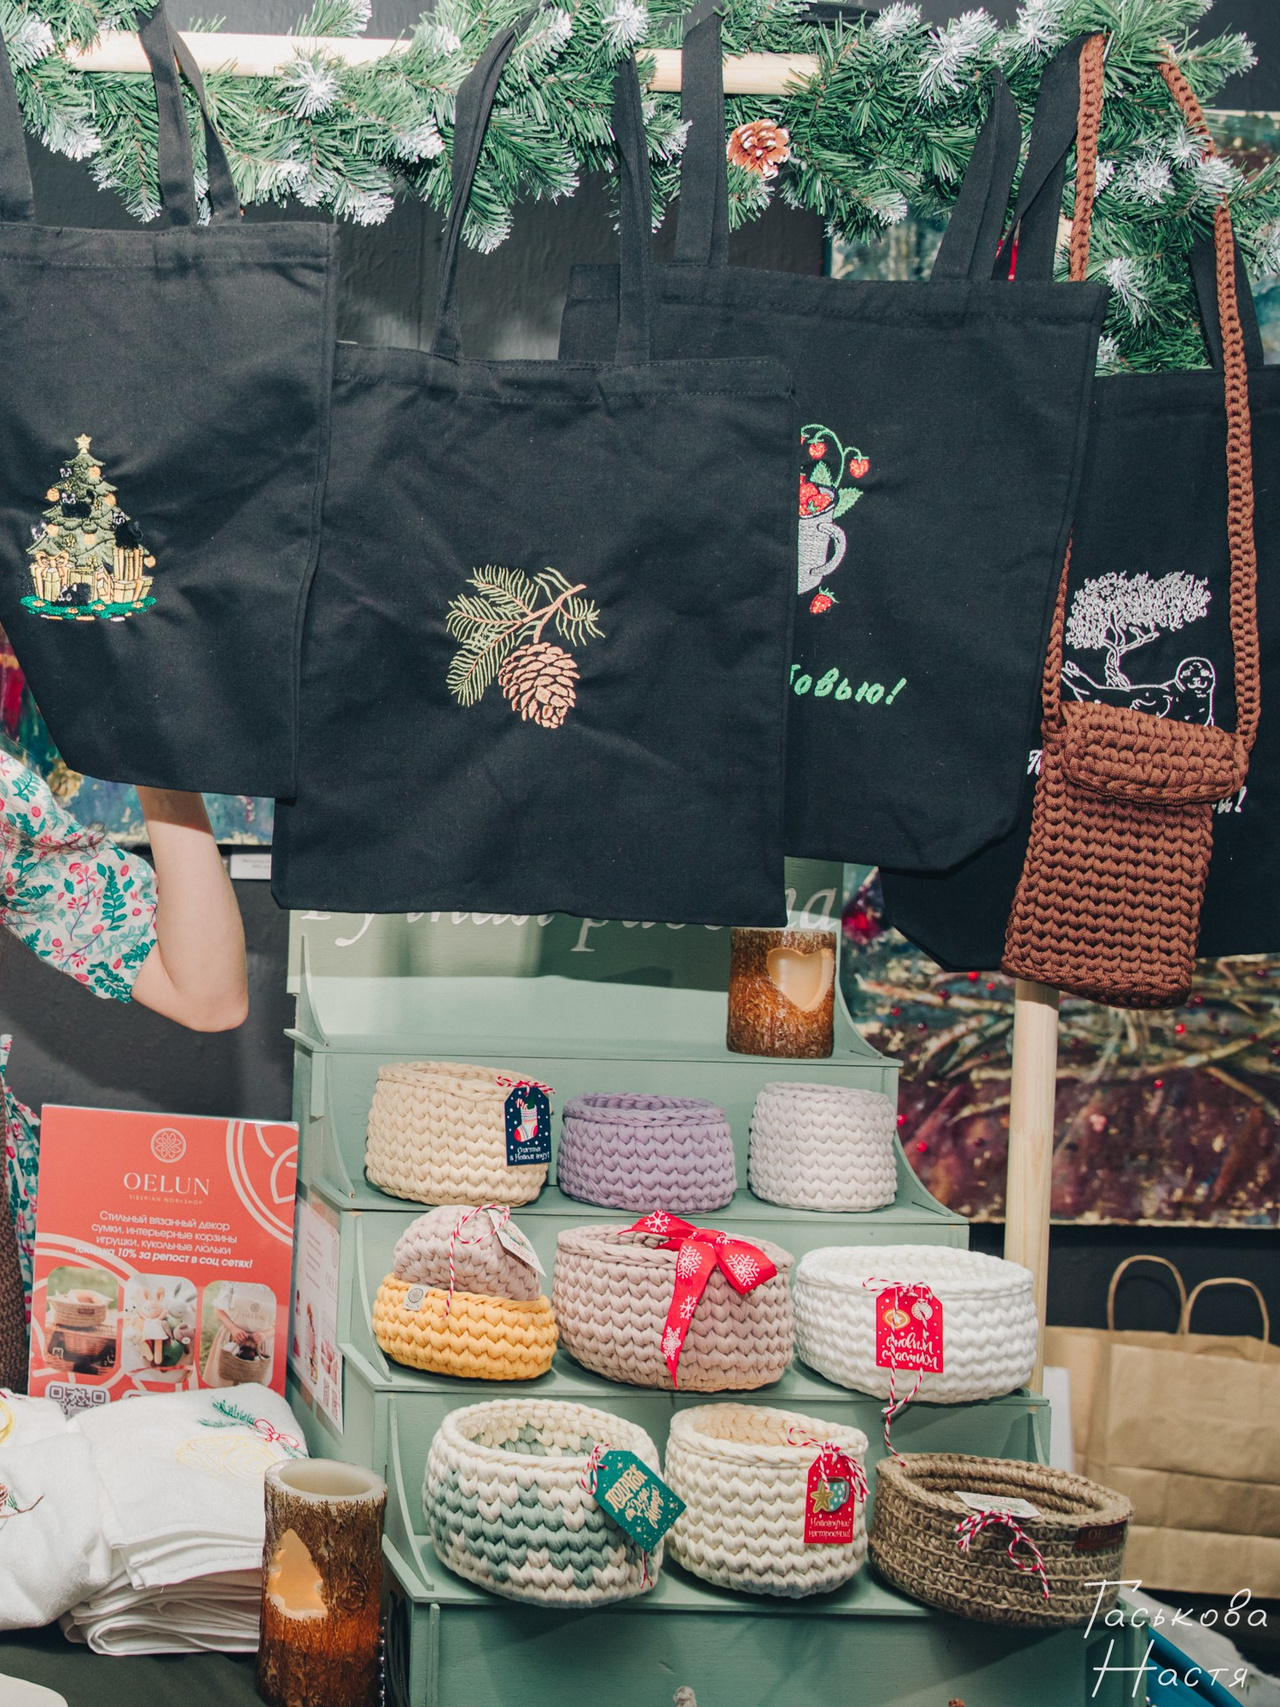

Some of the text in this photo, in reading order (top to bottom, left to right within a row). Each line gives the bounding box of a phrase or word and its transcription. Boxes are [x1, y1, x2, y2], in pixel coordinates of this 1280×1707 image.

[123, 1172, 210, 1196] OELUN
[129, 1194, 203, 1205] SIBERIAN WORKSHOP
[99, 1211, 231, 1232] Стильный вязанный декор
[126, 1227, 193, 1239] интерьерные
[194, 1233, 238, 1244] корзины
[141, 1239, 193, 1252] кукольные
[194, 1245, 232, 1255] люльки
[118, 1247, 137, 1258] 10%
[138, 1250, 151, 1260] за
[151, 1251, 190, 1264] репост
[190, 1256, 198, 1264] в
[199, 1256, 220, 1267] соц
[221, 1258, 253, 1269] сетях!
[605, 1464, 648, 1513] ПОДАРОК
